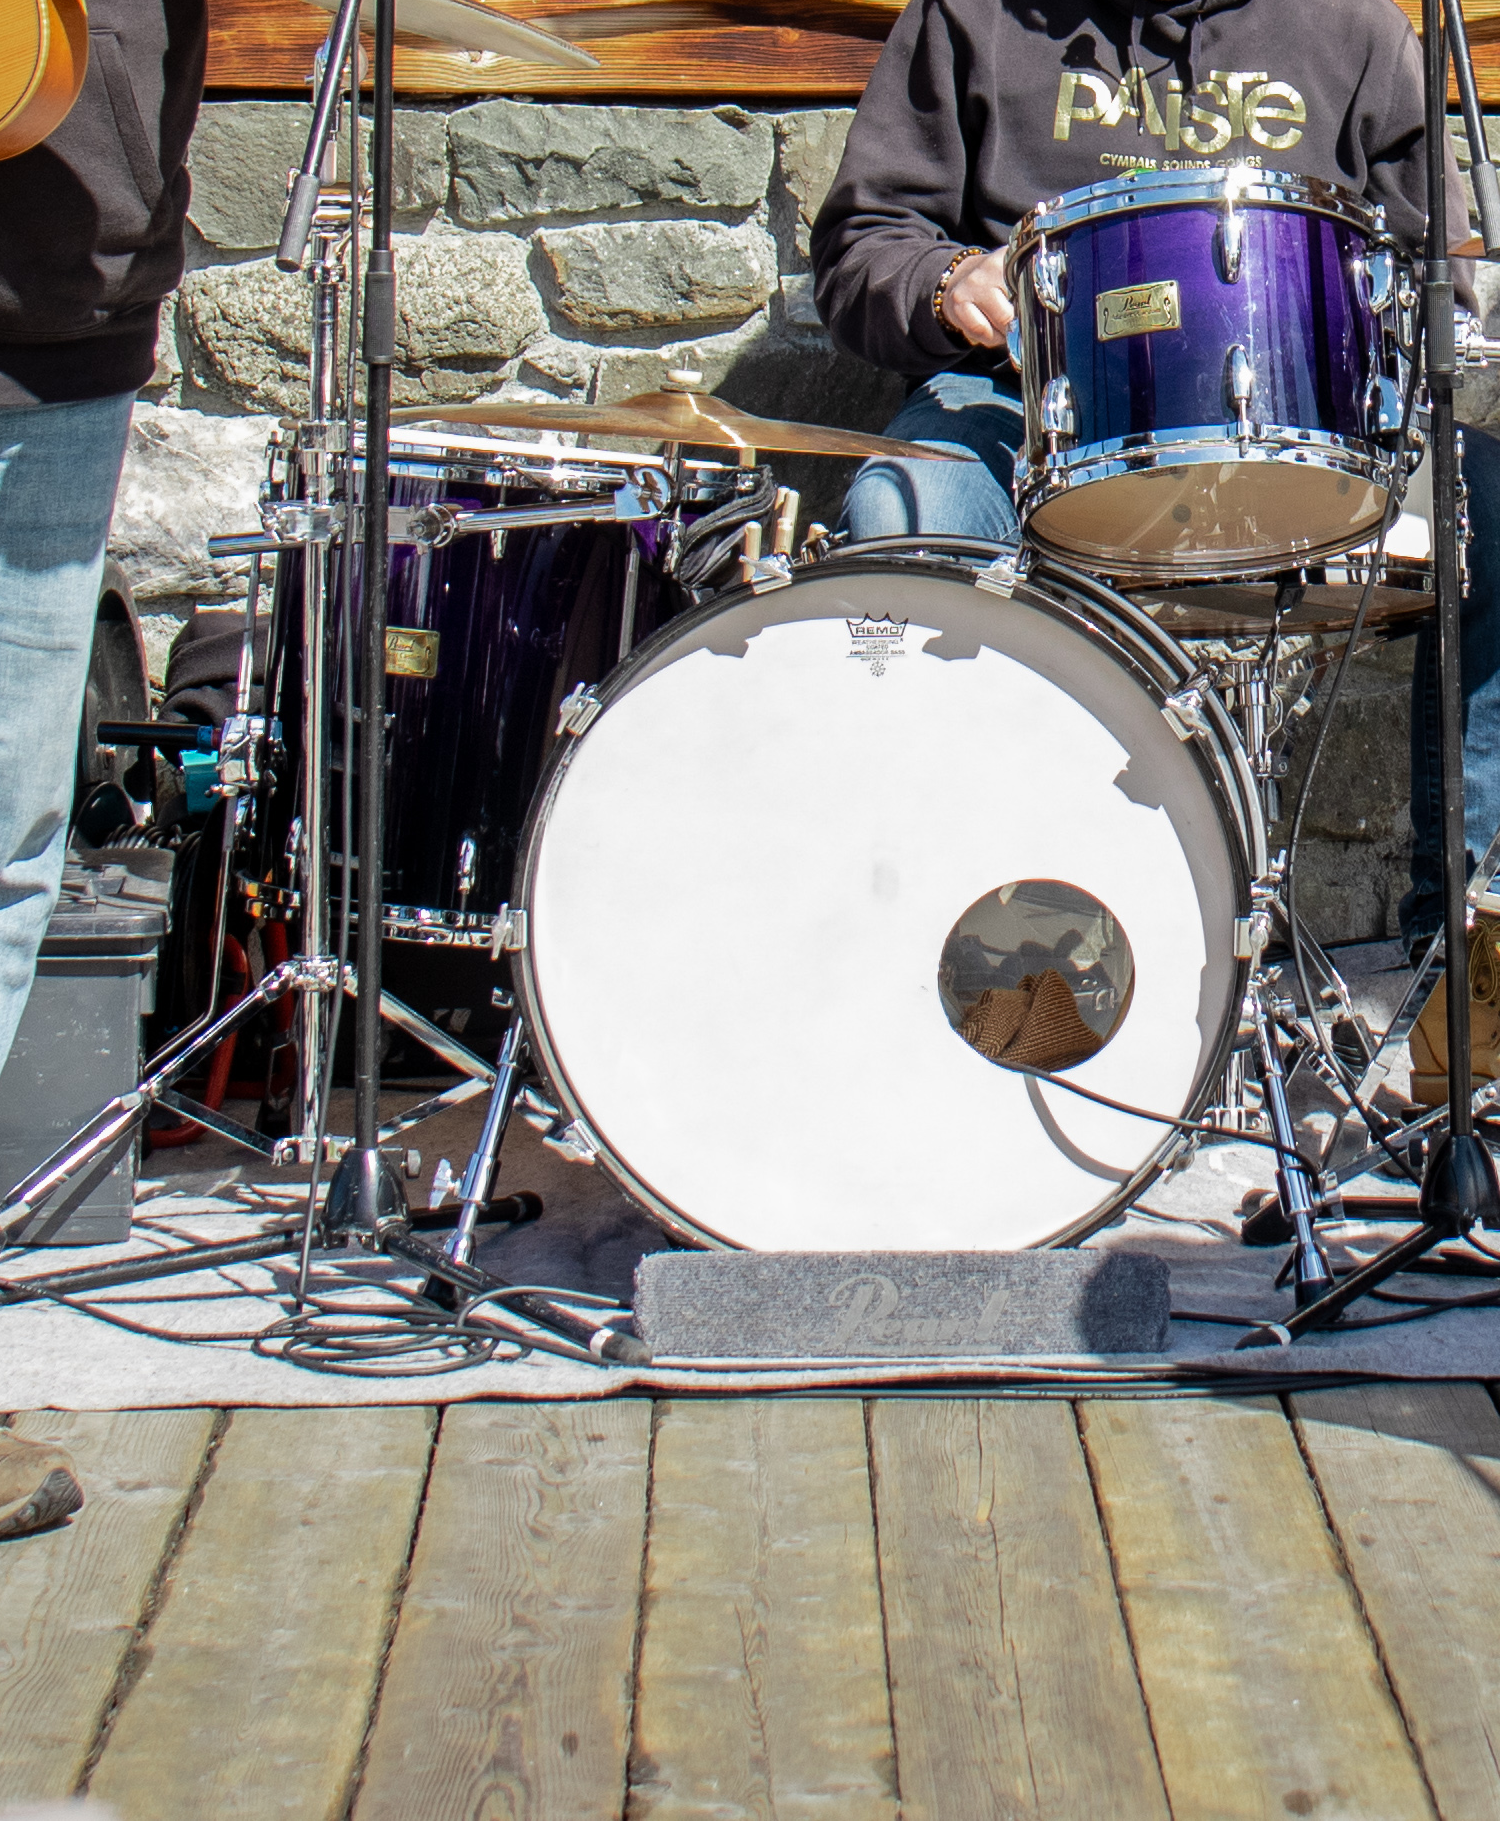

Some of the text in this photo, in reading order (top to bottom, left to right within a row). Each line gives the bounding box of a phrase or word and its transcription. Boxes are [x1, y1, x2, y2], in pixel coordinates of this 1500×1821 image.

[1100, 153, 1157, 169] CYMBALS
[1162, 159, 1211, 171] SOUNDS
[856, 626, 899, 634] REMO
